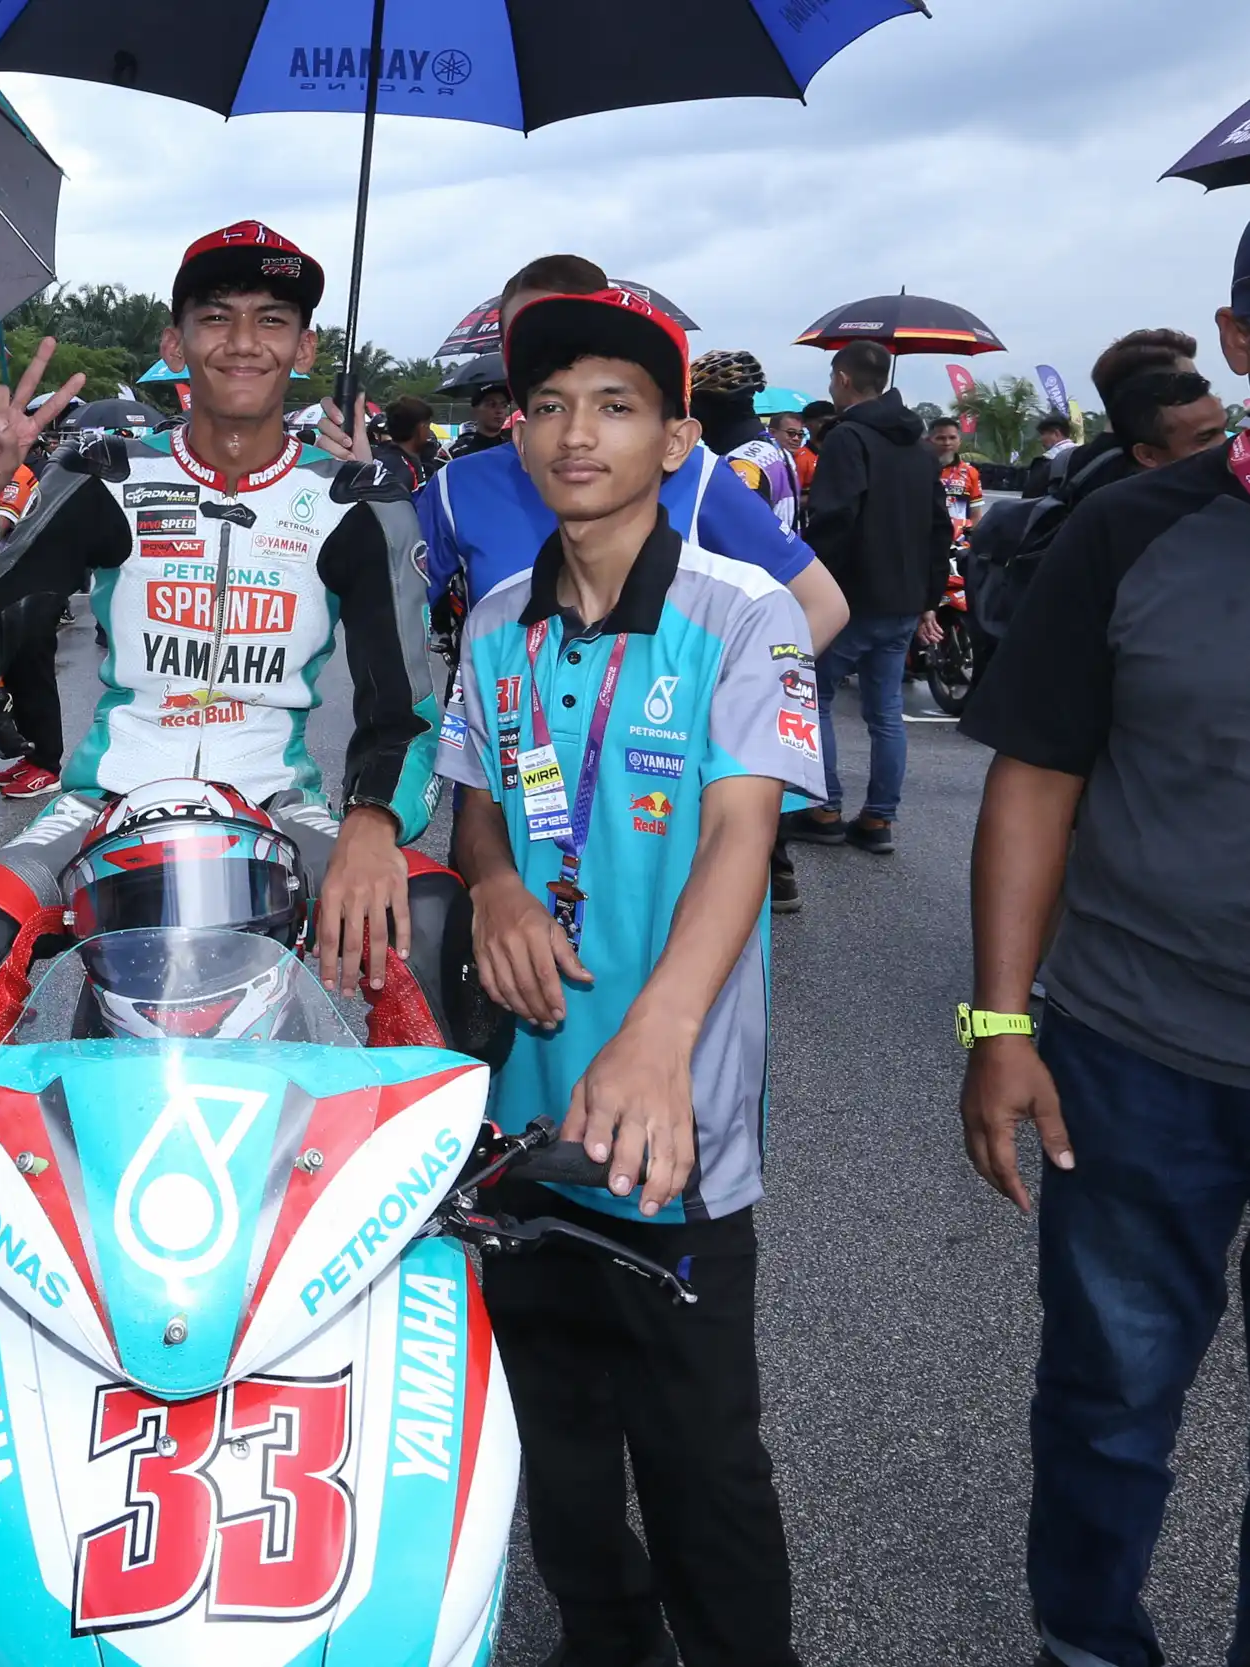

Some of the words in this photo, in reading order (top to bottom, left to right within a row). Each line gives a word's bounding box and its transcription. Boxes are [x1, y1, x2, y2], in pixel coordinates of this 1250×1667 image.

[743, 442, 766, 458] 067
[278, 520, 320, 536] PETRONAS
[267, 536, 308, 554] YAMAHA
[163, 563, 281, 587] PETRONAS
[143, 632, 286, 684] YAMAHA
[497, 676, 521, 714] 31
[160, 710, 200, 728] Red
[204, 701, 245, 724] Bull
[440, 726, 465, 743] UKA
[629, 725, 688, 741] PETRONAS
[778, 710, 817, 752] RK
[523, 765, 561, 786] WIRA
[529, 813, 570, 830] CP125
[633, 816, 656, 833] Red
[300, 1128, 463, 1318] PETRONAS
[392, 1273, 458, 1483] YAMAHA
[72, 1361, 357, 1638] 33
